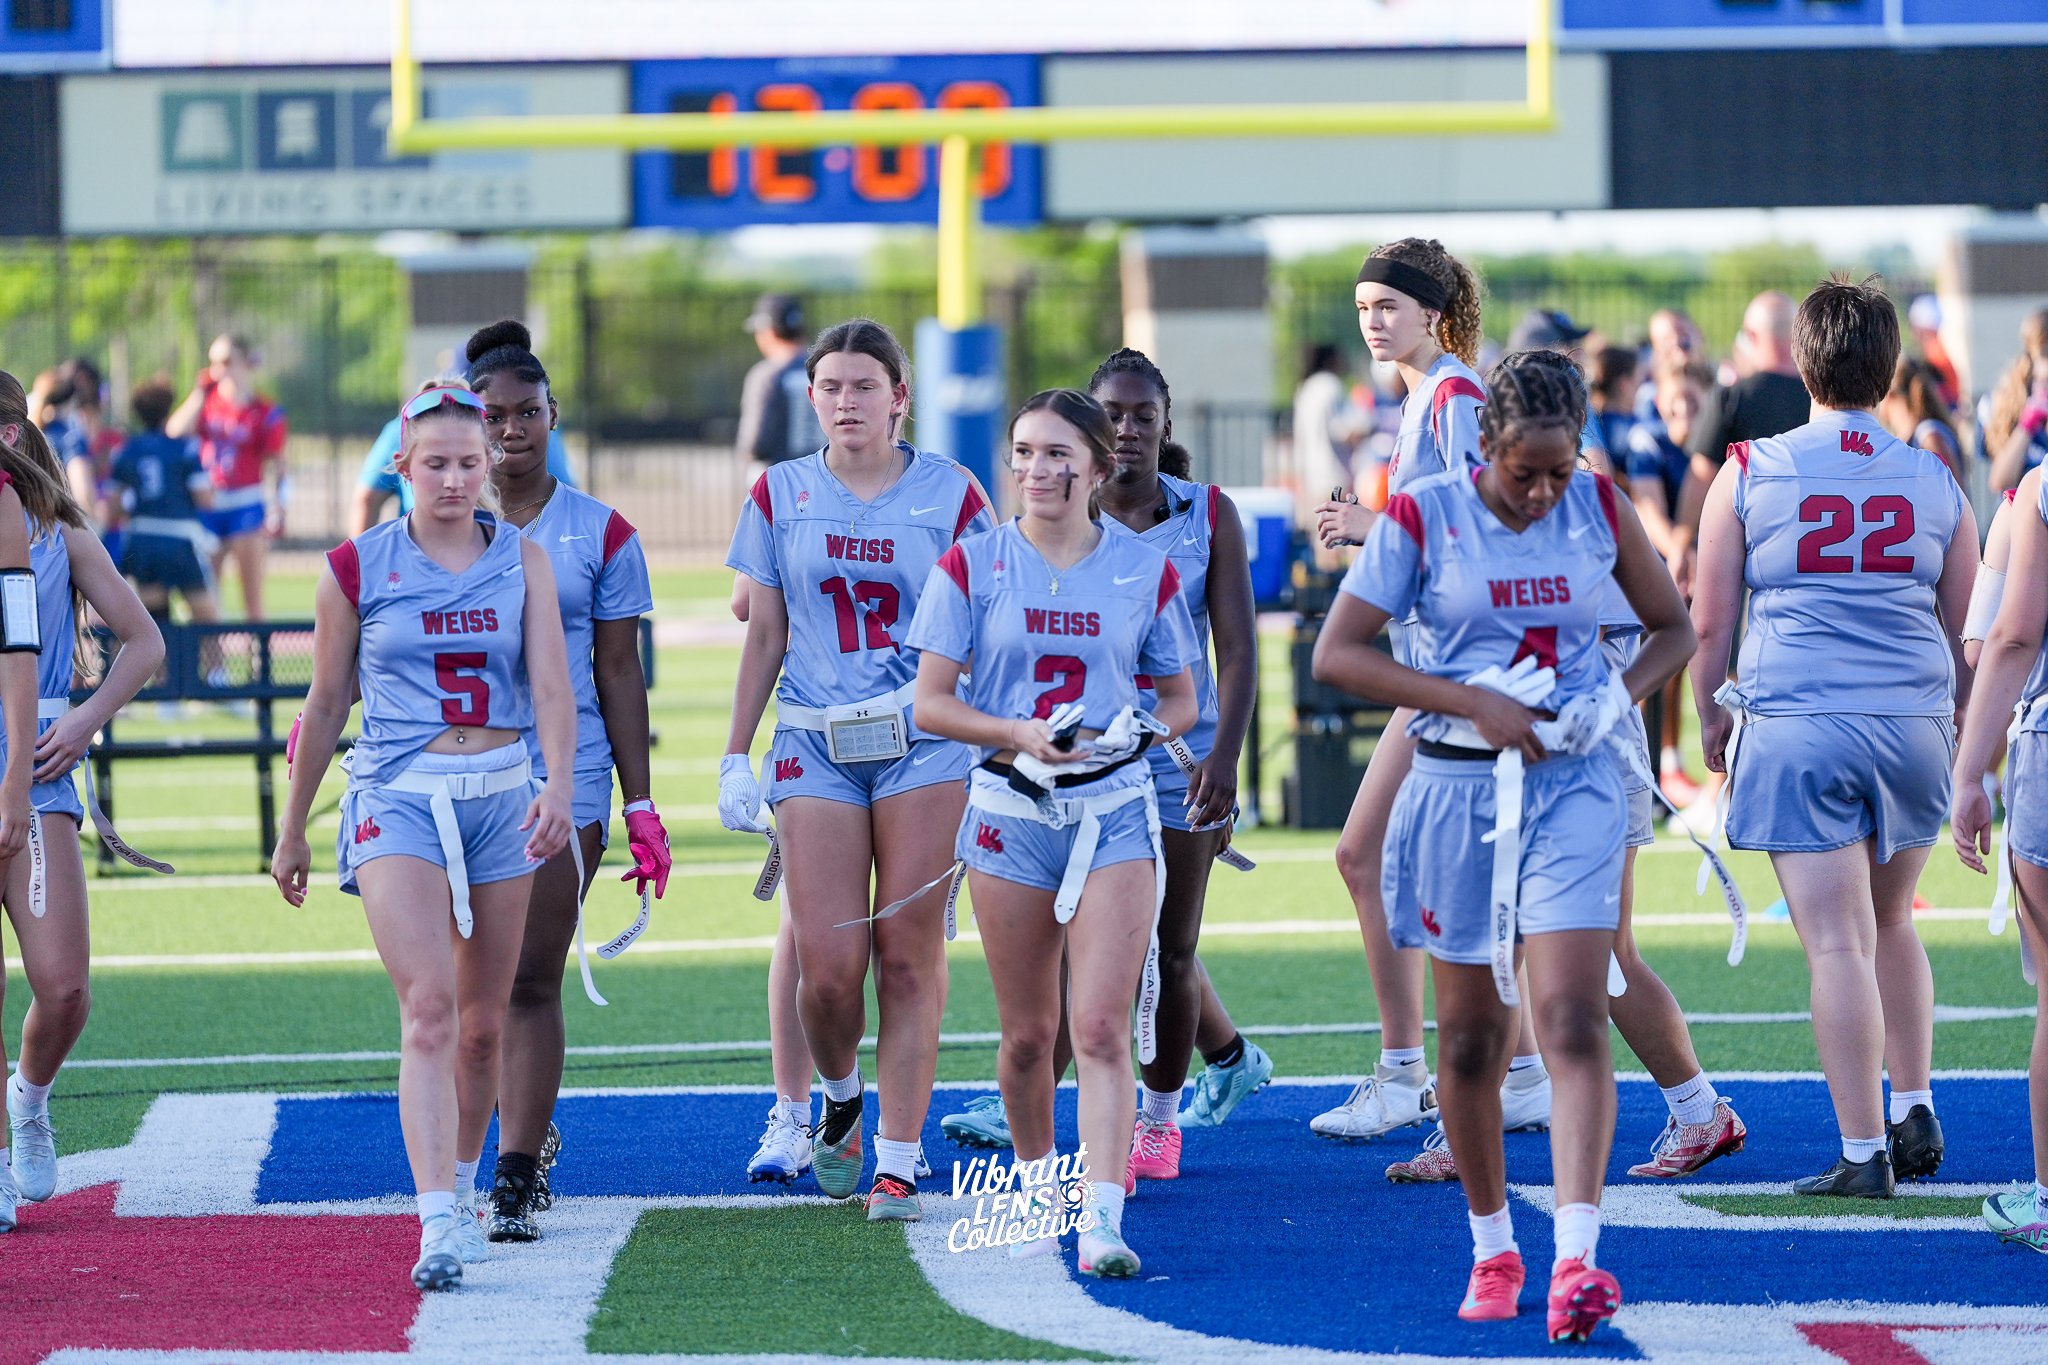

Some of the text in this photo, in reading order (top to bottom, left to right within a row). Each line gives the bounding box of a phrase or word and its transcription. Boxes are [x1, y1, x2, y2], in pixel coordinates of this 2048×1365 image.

[707, 81, 1012, 203] 12:00
[155, 178, 533, 219] LIVING SPACES
[825, 533, 895, 564] WEISS
[1797, 494, 1915, 573] 22
[819, 576, 900, 654] 12
[1488, 576, 1571, 608] WEISS
[421, 608, 499, 635] WEISS
[1024, 608, 1101, 637] WEISS
[434, 652, 490, 727] 5
[1032, 654, 1087, 720] 2
